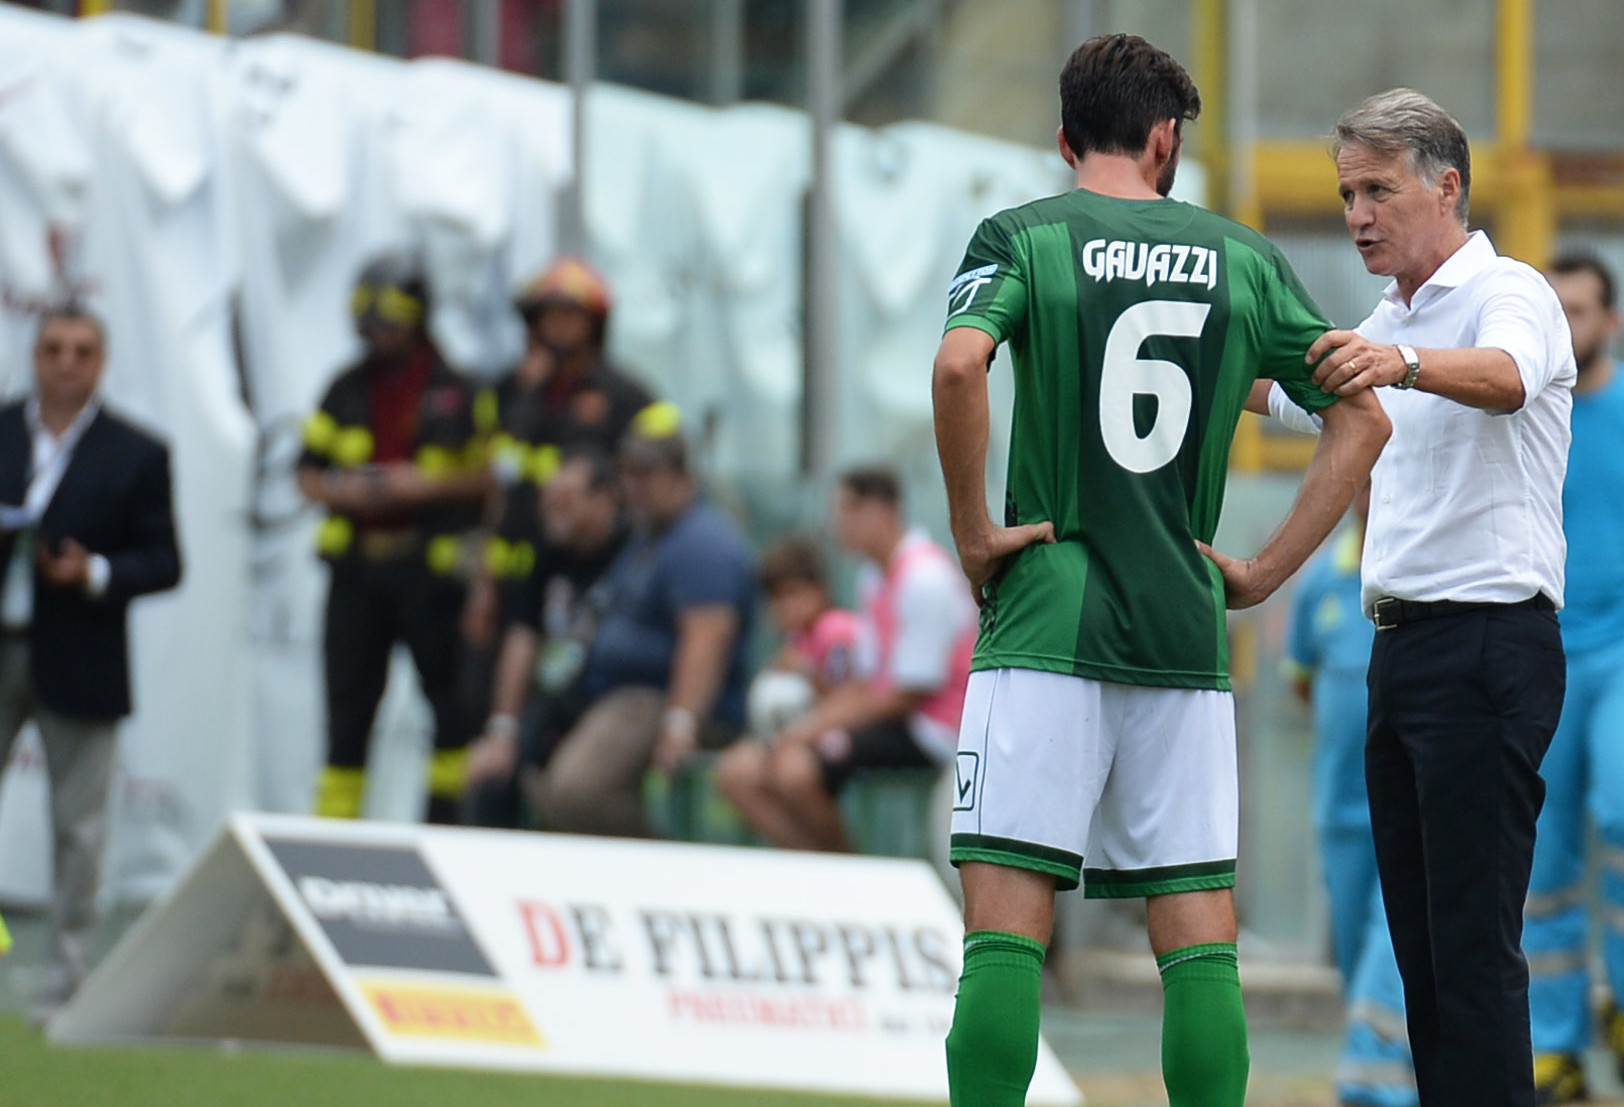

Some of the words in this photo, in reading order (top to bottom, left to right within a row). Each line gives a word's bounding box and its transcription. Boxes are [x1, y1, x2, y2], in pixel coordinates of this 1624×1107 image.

[1082, 239, 1217, 290] GAVAZZI
[1099, 300, 1212, 474] 6
[515, 900, 624, 972] DE
[638, 908, 960, 994] FILIPPIS
